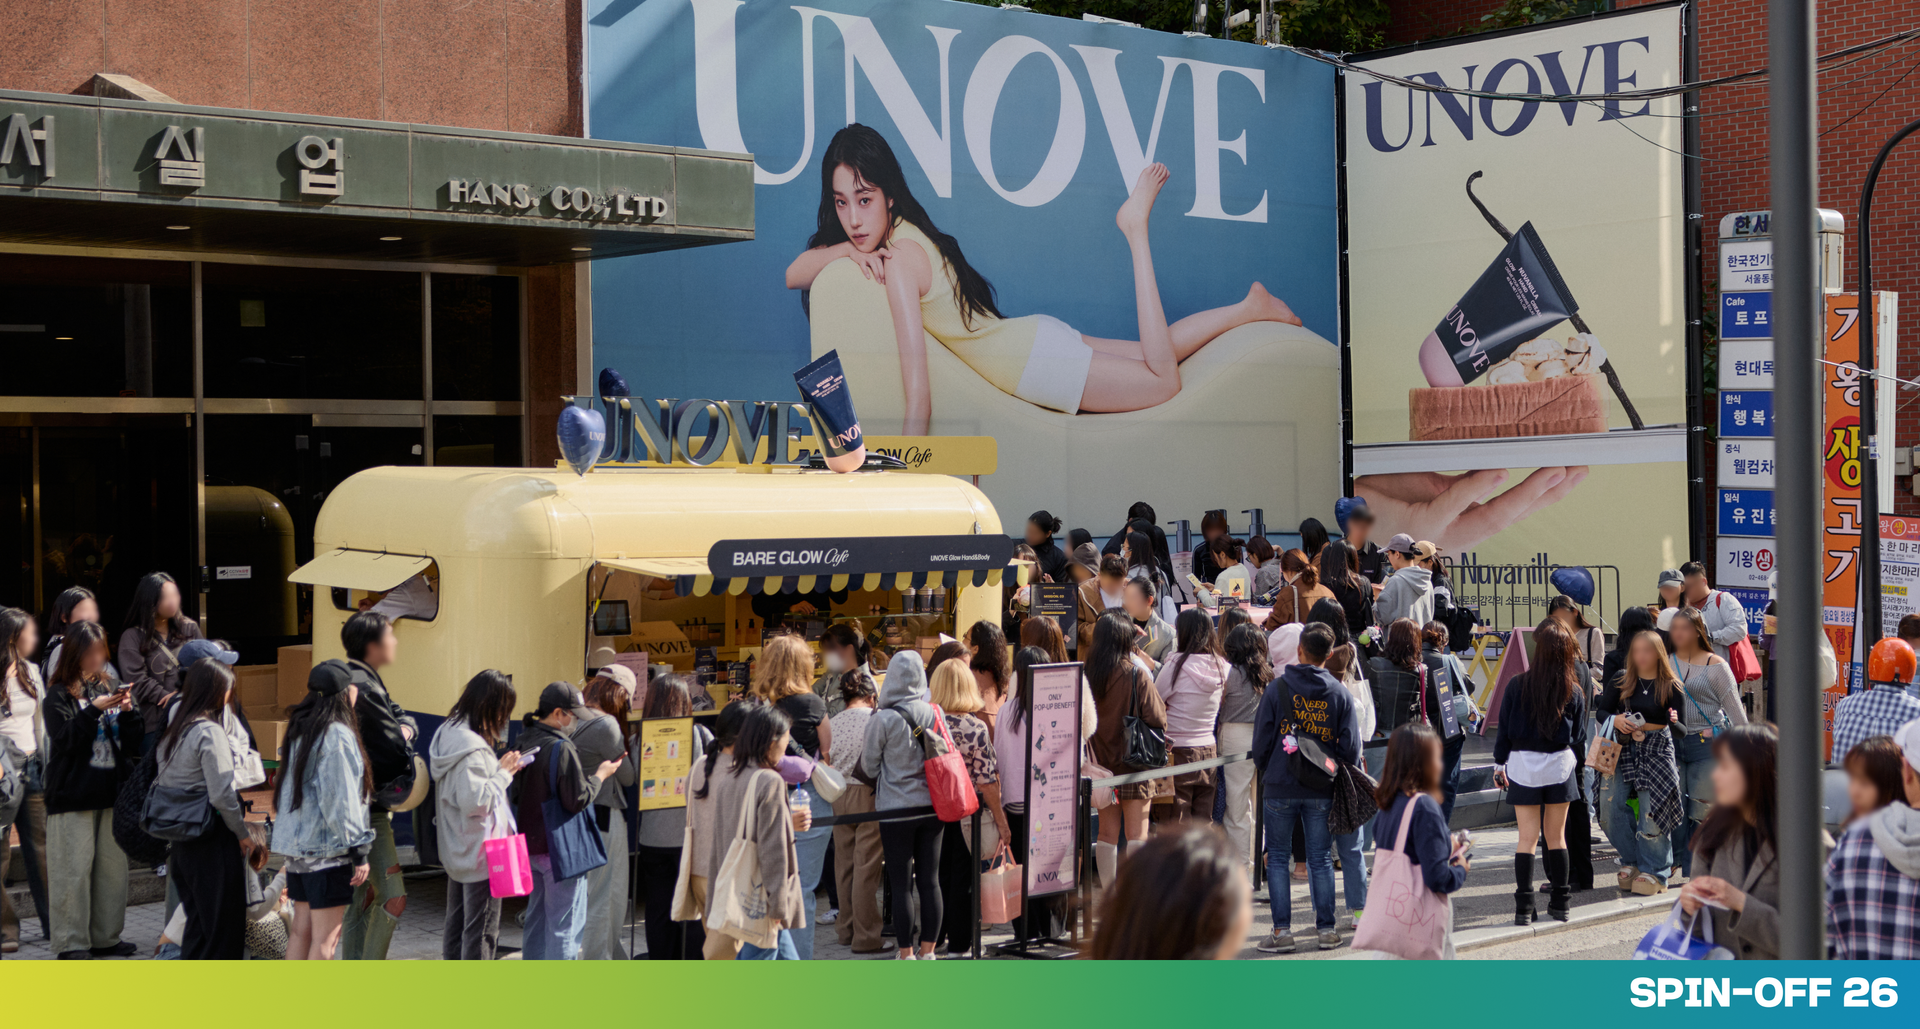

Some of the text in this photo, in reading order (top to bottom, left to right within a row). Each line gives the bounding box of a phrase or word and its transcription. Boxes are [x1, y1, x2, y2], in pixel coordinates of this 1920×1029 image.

[1360, 36, 1650, 153] UNOVE
[691, 0, 1268, 223] UNOVE
[1735, 214, 1768, 235] 한서
[1504, 257, 1516, 272] GLOW
[1517, 278, 1528, 293] HAND
[1517, 266, 1539, 299] NUVANILLA
[1726, 297, 1745, 306] Cafe
[1446, 305, 1490, 373] UNOVE
[1725, 394, 1741, 404] 한식
[1734, 410, 1775, 427] 행복
[904, 446, 932, 467] Cafe
[1725, 444, 1740, 453] 중식
[1733, 459, 1774, 475] 웰컴차
[1724, 493, 1739, 503] 일식
[733, 548, 849, 567] BARE GLOW Cafe
[930, 554, 948, 562] UNOVE
[948, 554, 961, 562] Glow
[1505, 595, 1530, 606] 소프트
[1824, 609, 1839, 622] 일요일
[636, 640, 691, 656] UNOVE
[1048, 693, 1062, 701] ONLY
[1034, 700, 1076, 711] POP-UP BENEFIT
